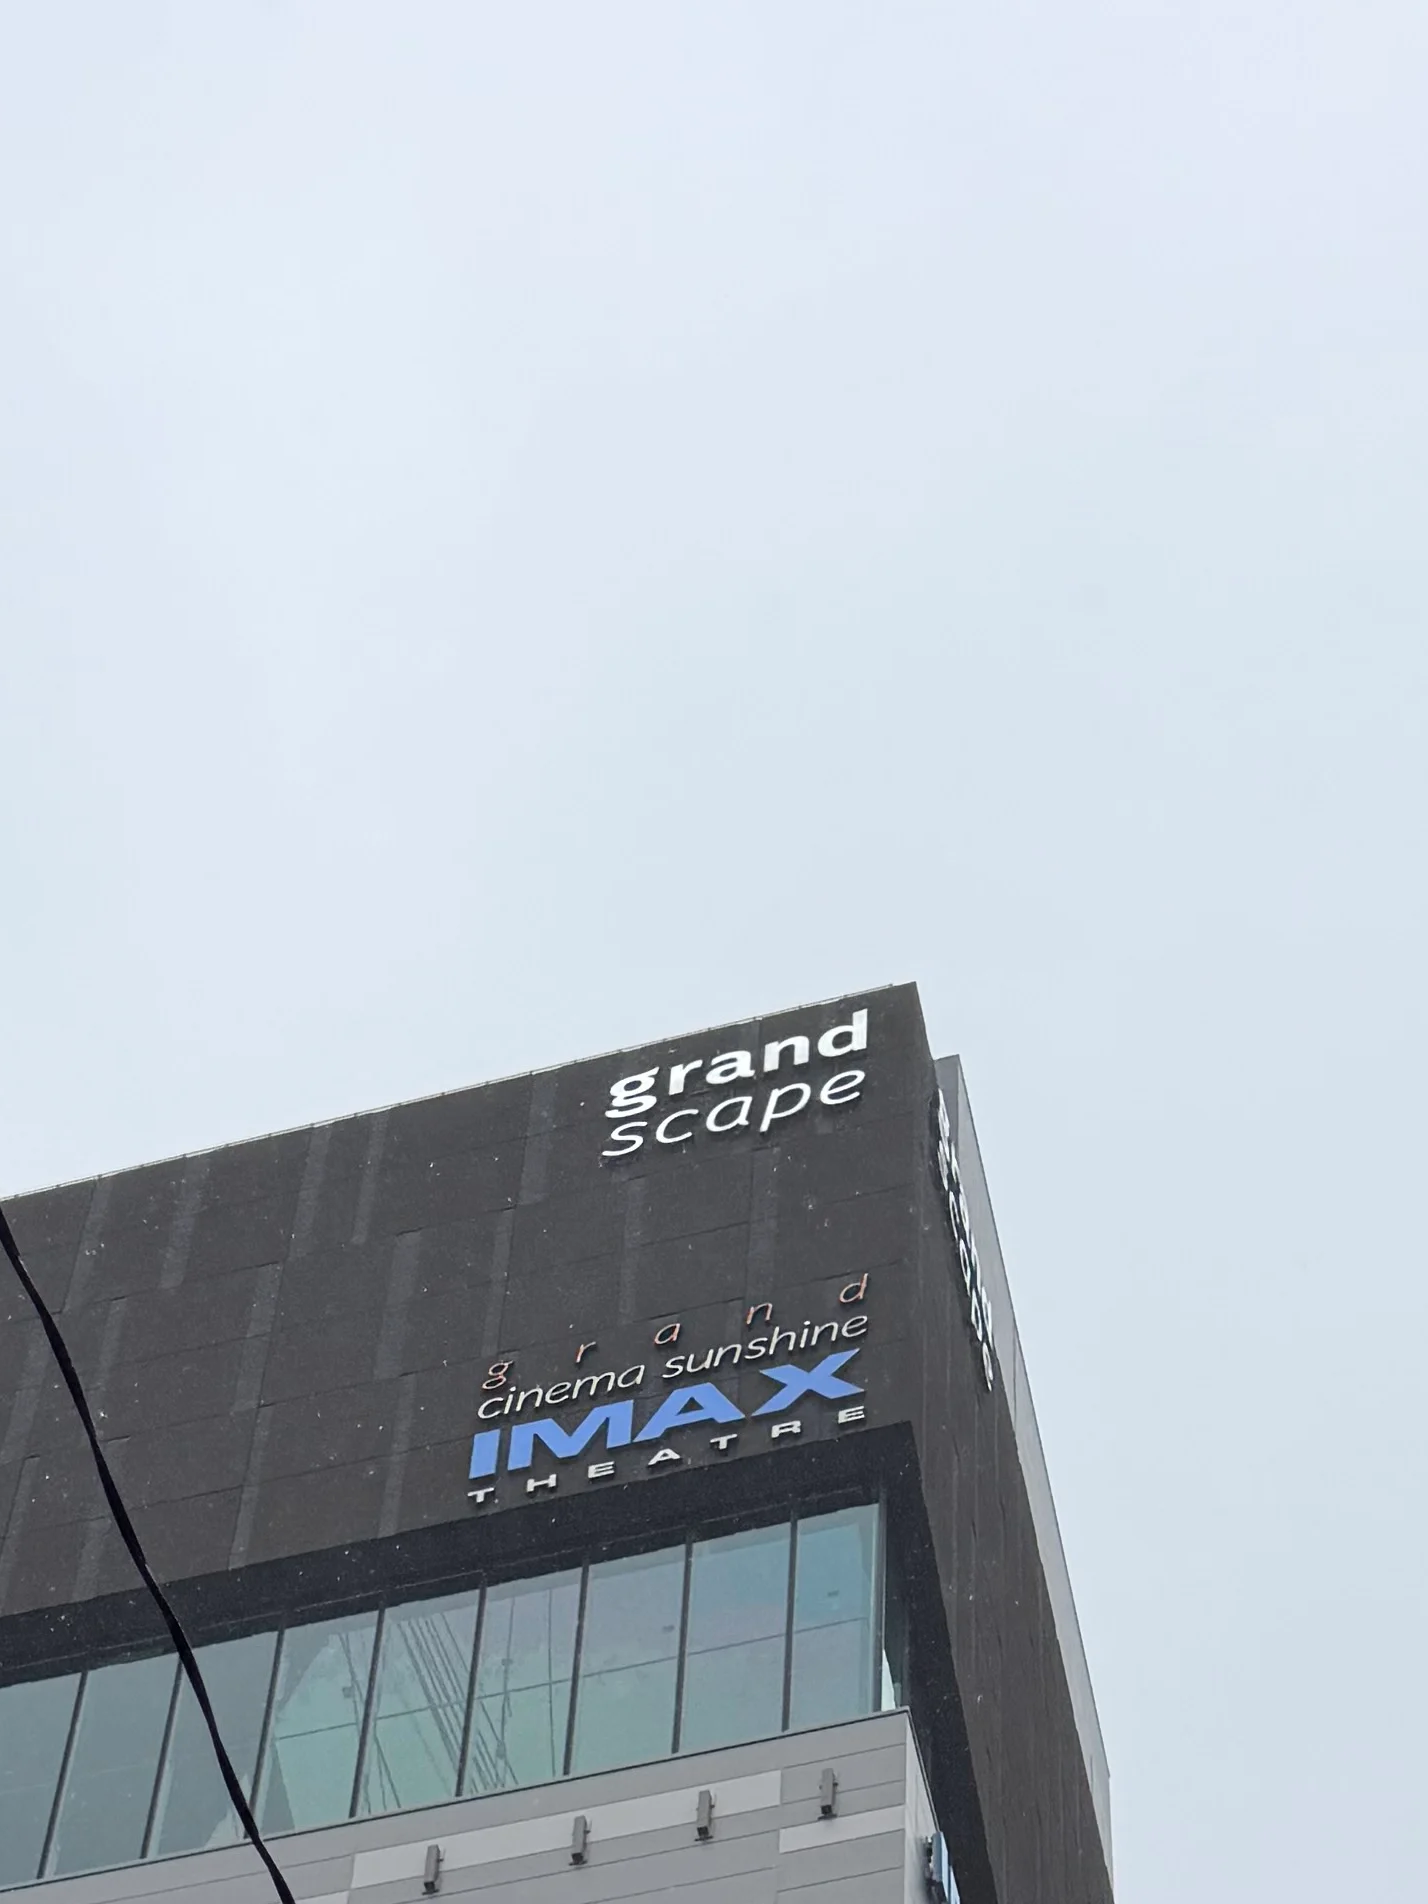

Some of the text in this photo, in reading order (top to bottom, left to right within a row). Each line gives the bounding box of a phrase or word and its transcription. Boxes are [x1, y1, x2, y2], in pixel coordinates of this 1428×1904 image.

[600, 1066, 867, 1158] scape
[603, 1007, 870, 1120] grand
[477, 1311, 870, 1421] cinema sunshine
[480, 1272, 870, 1390] grand
[466, 1347, 866, 1480] IMAX
[466, 1404, 867, 1505] THEATRE
